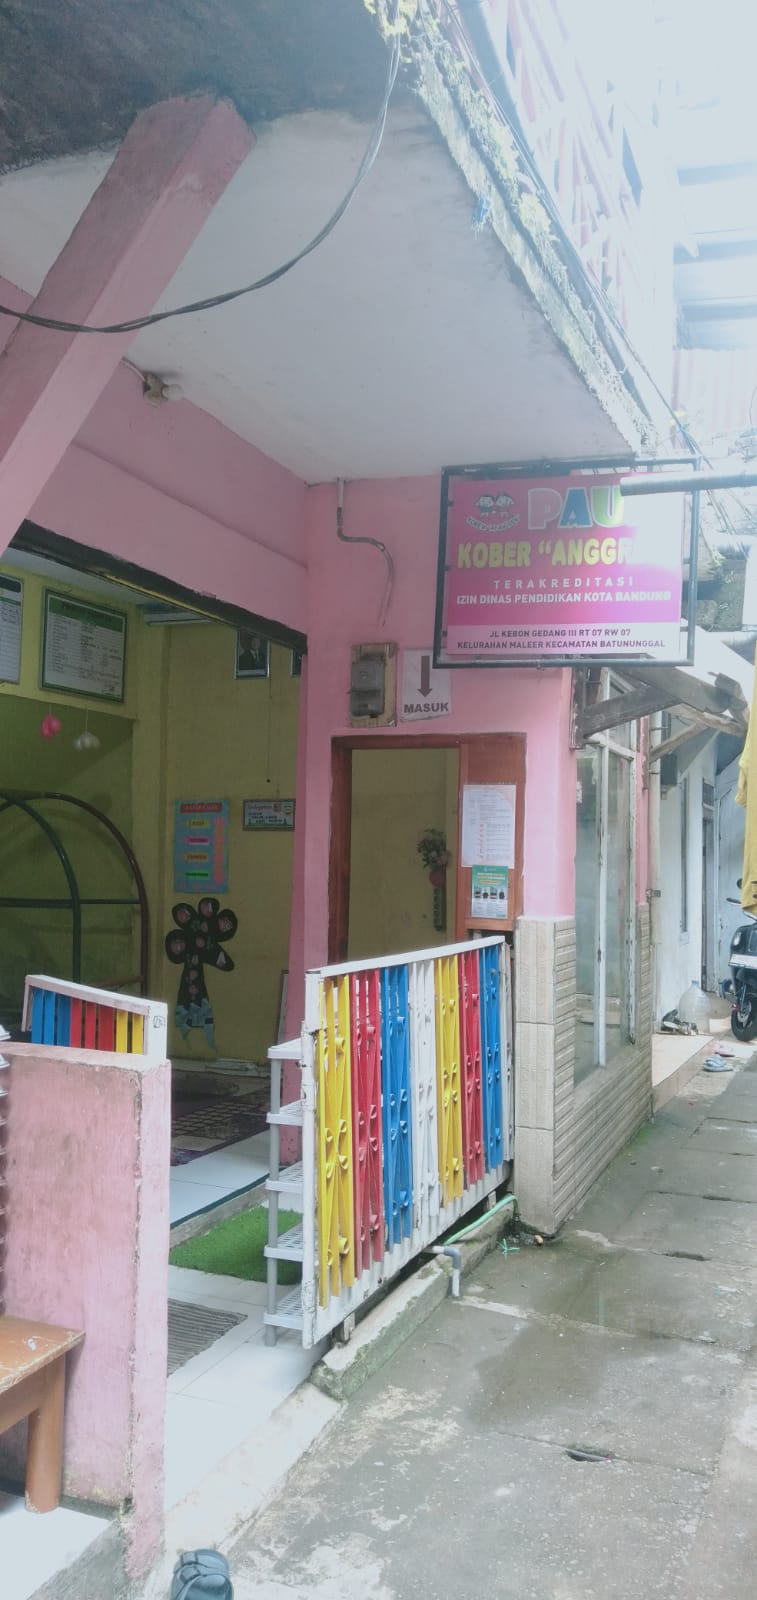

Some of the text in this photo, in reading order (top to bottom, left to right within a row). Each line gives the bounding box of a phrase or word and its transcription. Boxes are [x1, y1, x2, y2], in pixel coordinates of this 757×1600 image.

[527, 485, 627, 530] PAU
[457, 540, 531, 569] KOBER
[494, 576, 633, 590] TERAKREDITASI
[456, 590, 671, 605] IZIN DINAS PENDIDIKAN KOTA BANDUNG
[489, 630, 500, 638] JL
[501, 630, 530, 638] KEBON
[532, 629, 566, 637] GEDANG
[579, 629, 590, 637] RT
[592, 629, 602, 637] 07
[604, 628, 619, 637] RW
[620, 628, 631, 636] 07
[457, 641, 508, 649] KELURAHAN
[509, 640, 544, 649] MALEER
[545, 640, 598, 648] KECAMATAN
[403, 702, 449, 714] MASUK
